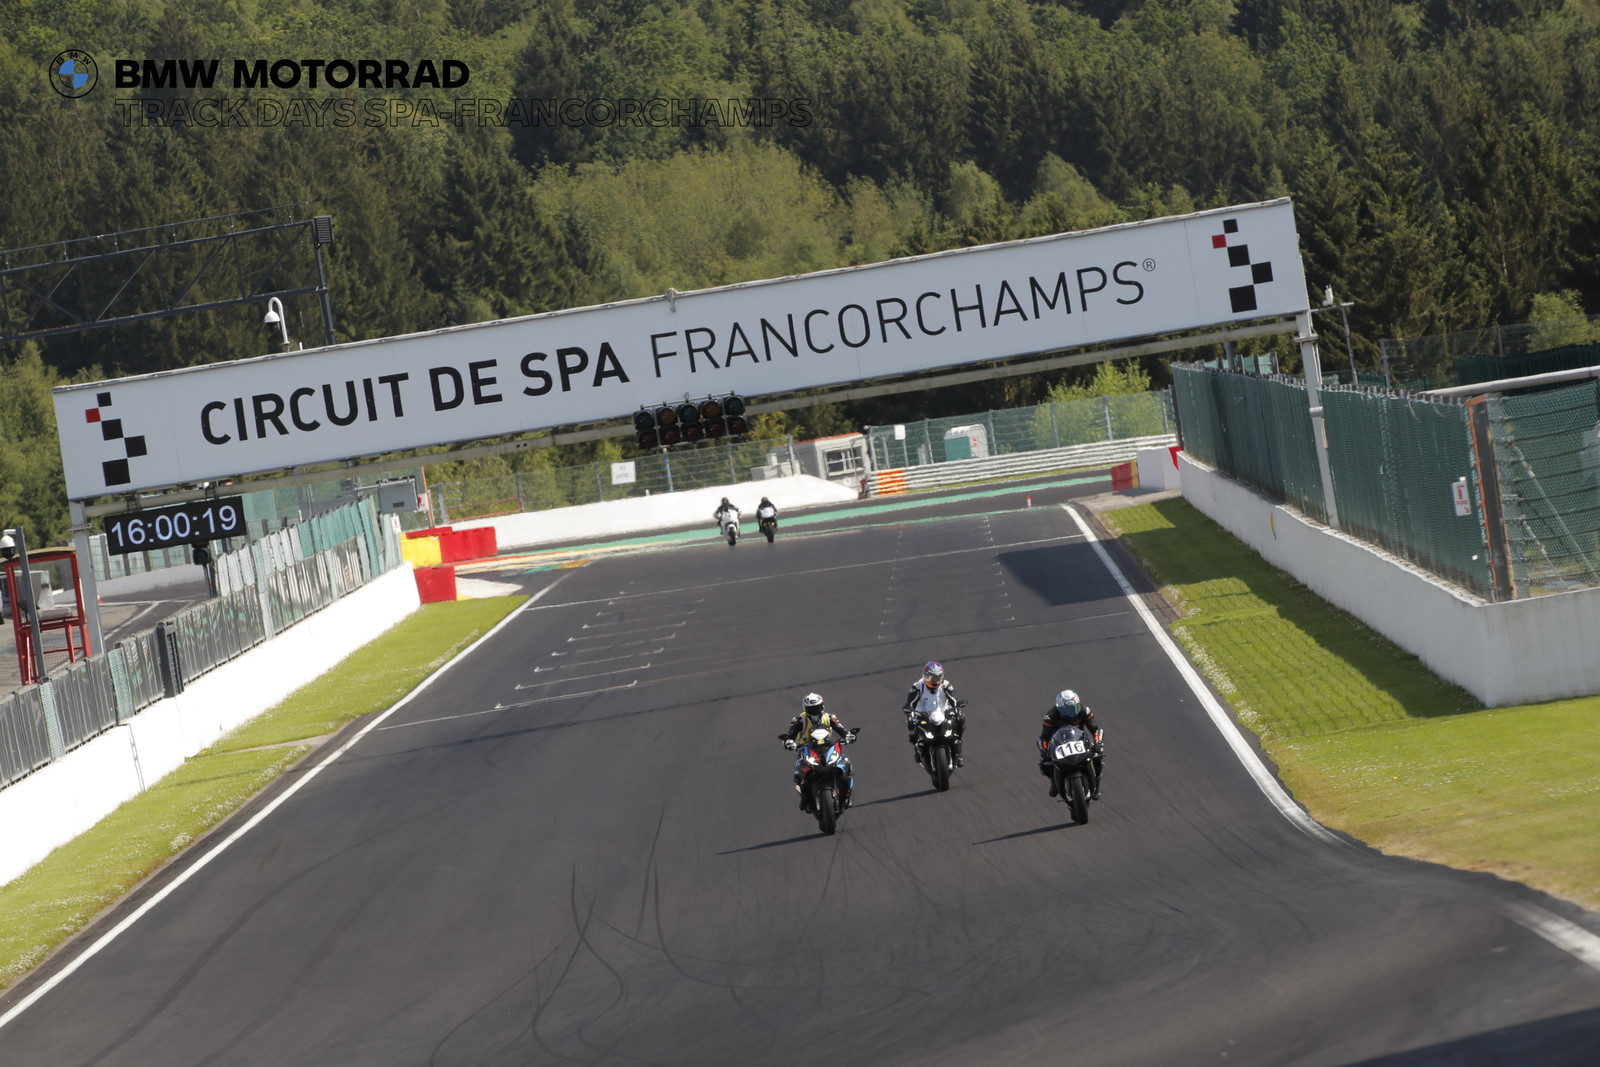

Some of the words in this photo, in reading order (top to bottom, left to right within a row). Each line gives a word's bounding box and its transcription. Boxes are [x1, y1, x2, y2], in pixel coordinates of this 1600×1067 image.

[201, 371, 419, 446] CIRCUIT
[428, 358, 503, 412] DE
[519, 341, 630, 397] SPA
[111, 505, 237, 547] 16:00:19
[1057, 741, 1084, 757] 116
